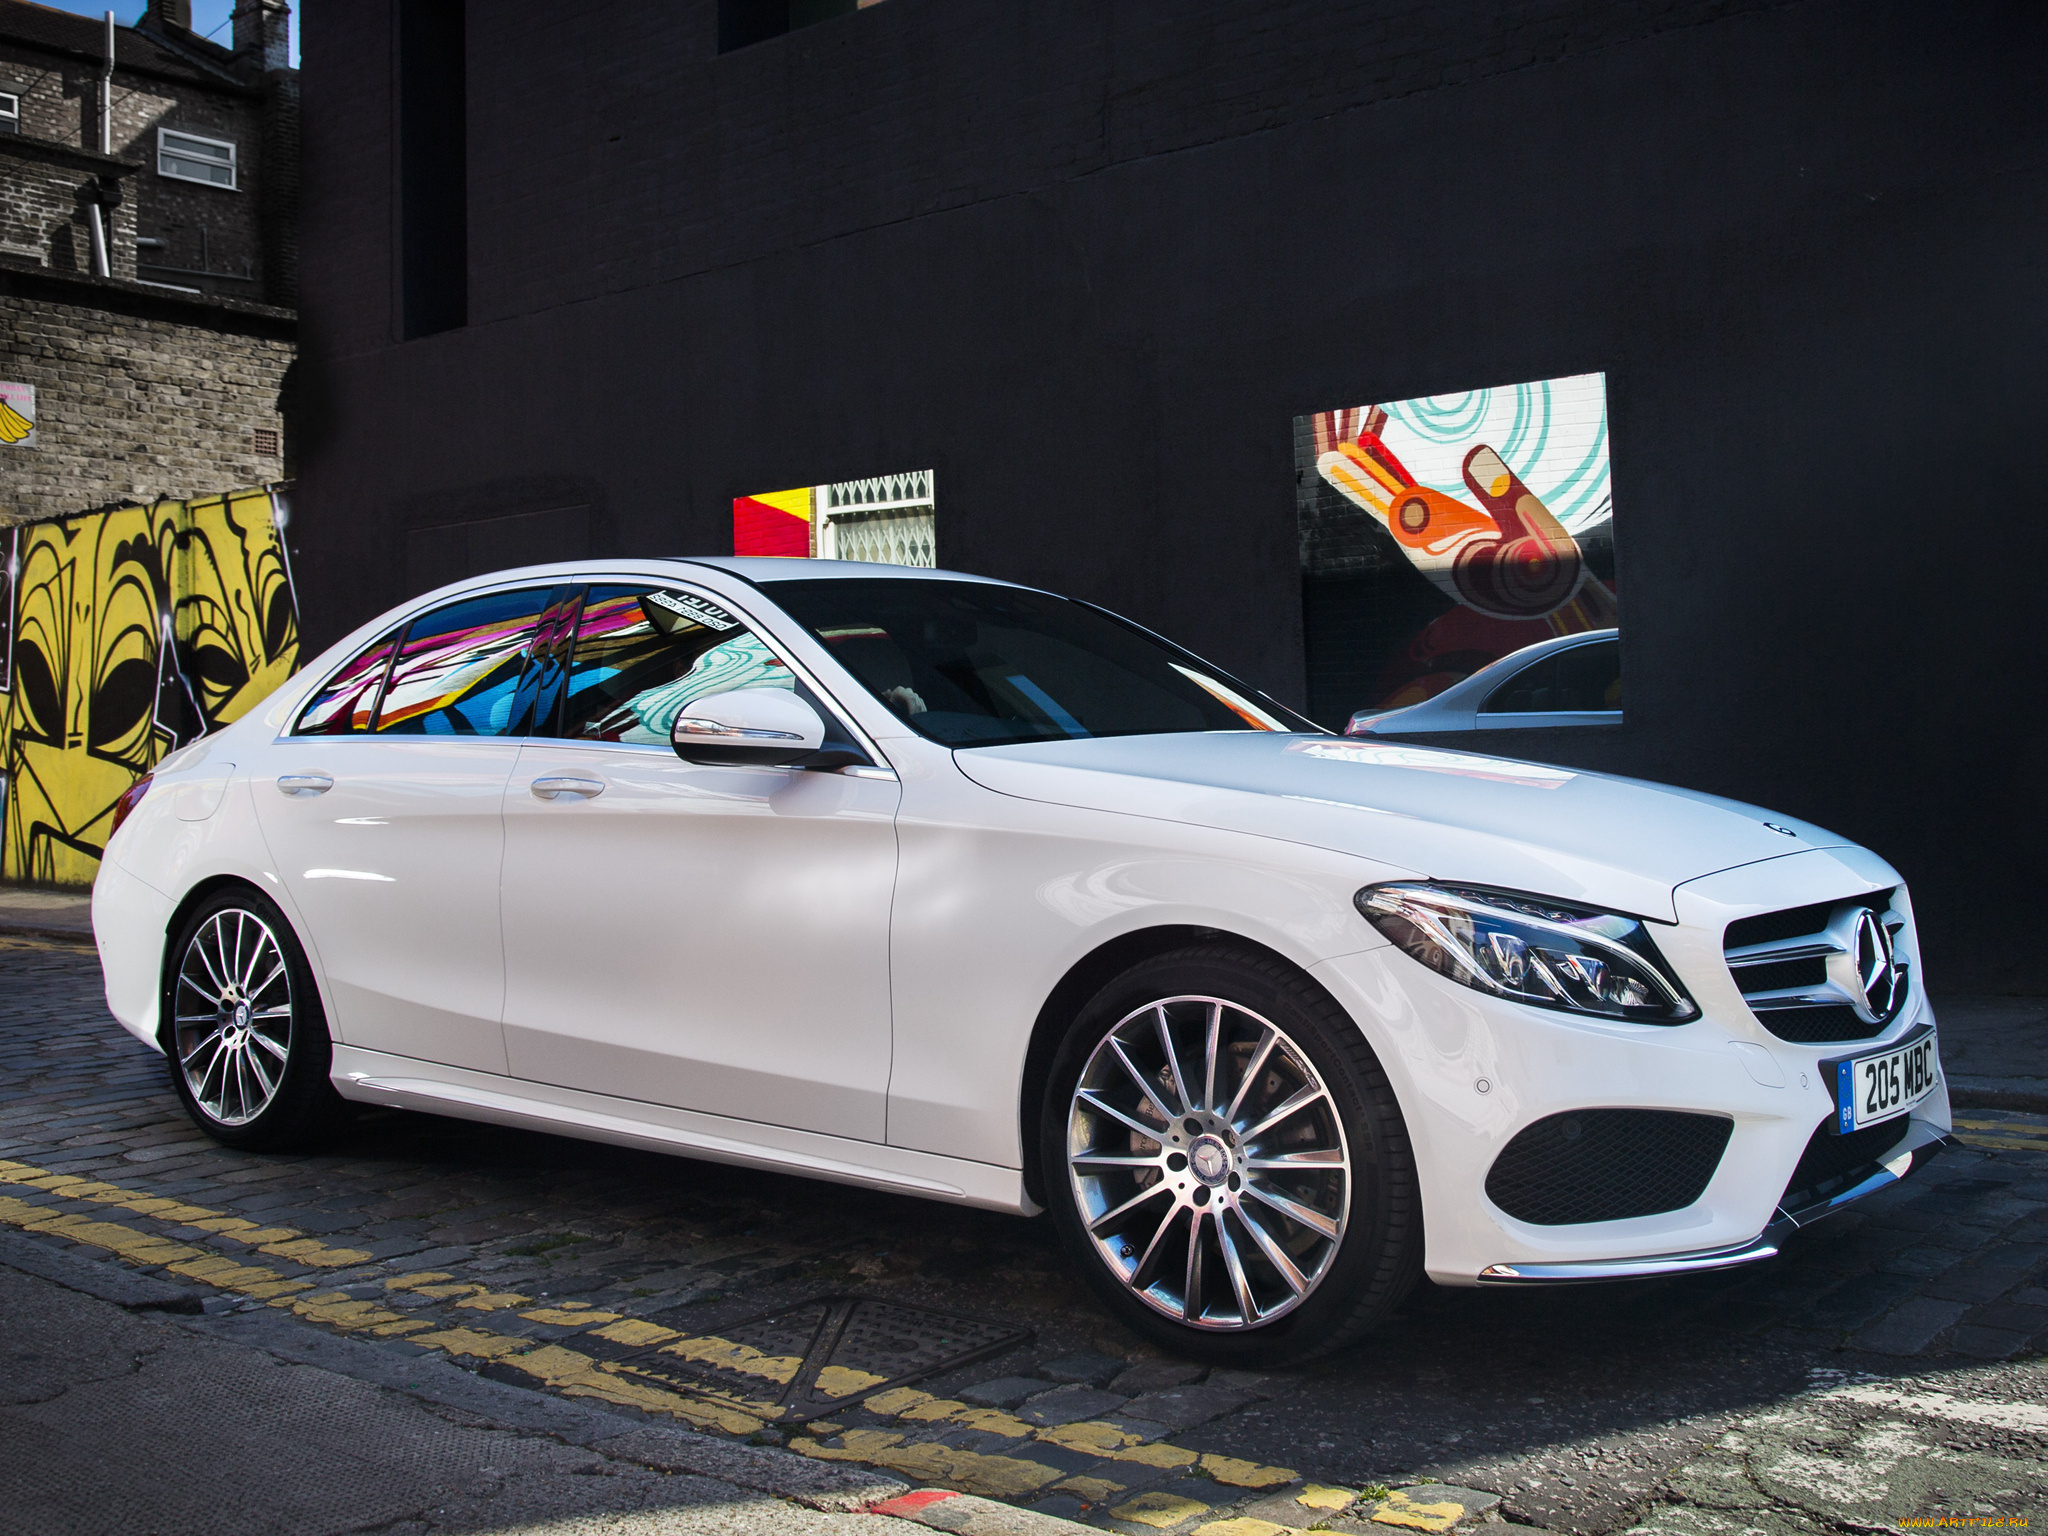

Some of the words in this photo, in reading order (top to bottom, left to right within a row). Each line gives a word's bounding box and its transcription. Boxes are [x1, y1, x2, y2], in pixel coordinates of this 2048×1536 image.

[1865, 1055, 1900, 1114] 205
[1904, 1040, 1933, 1100] MBC
[1842, 1106, 1852, 1121] GB
